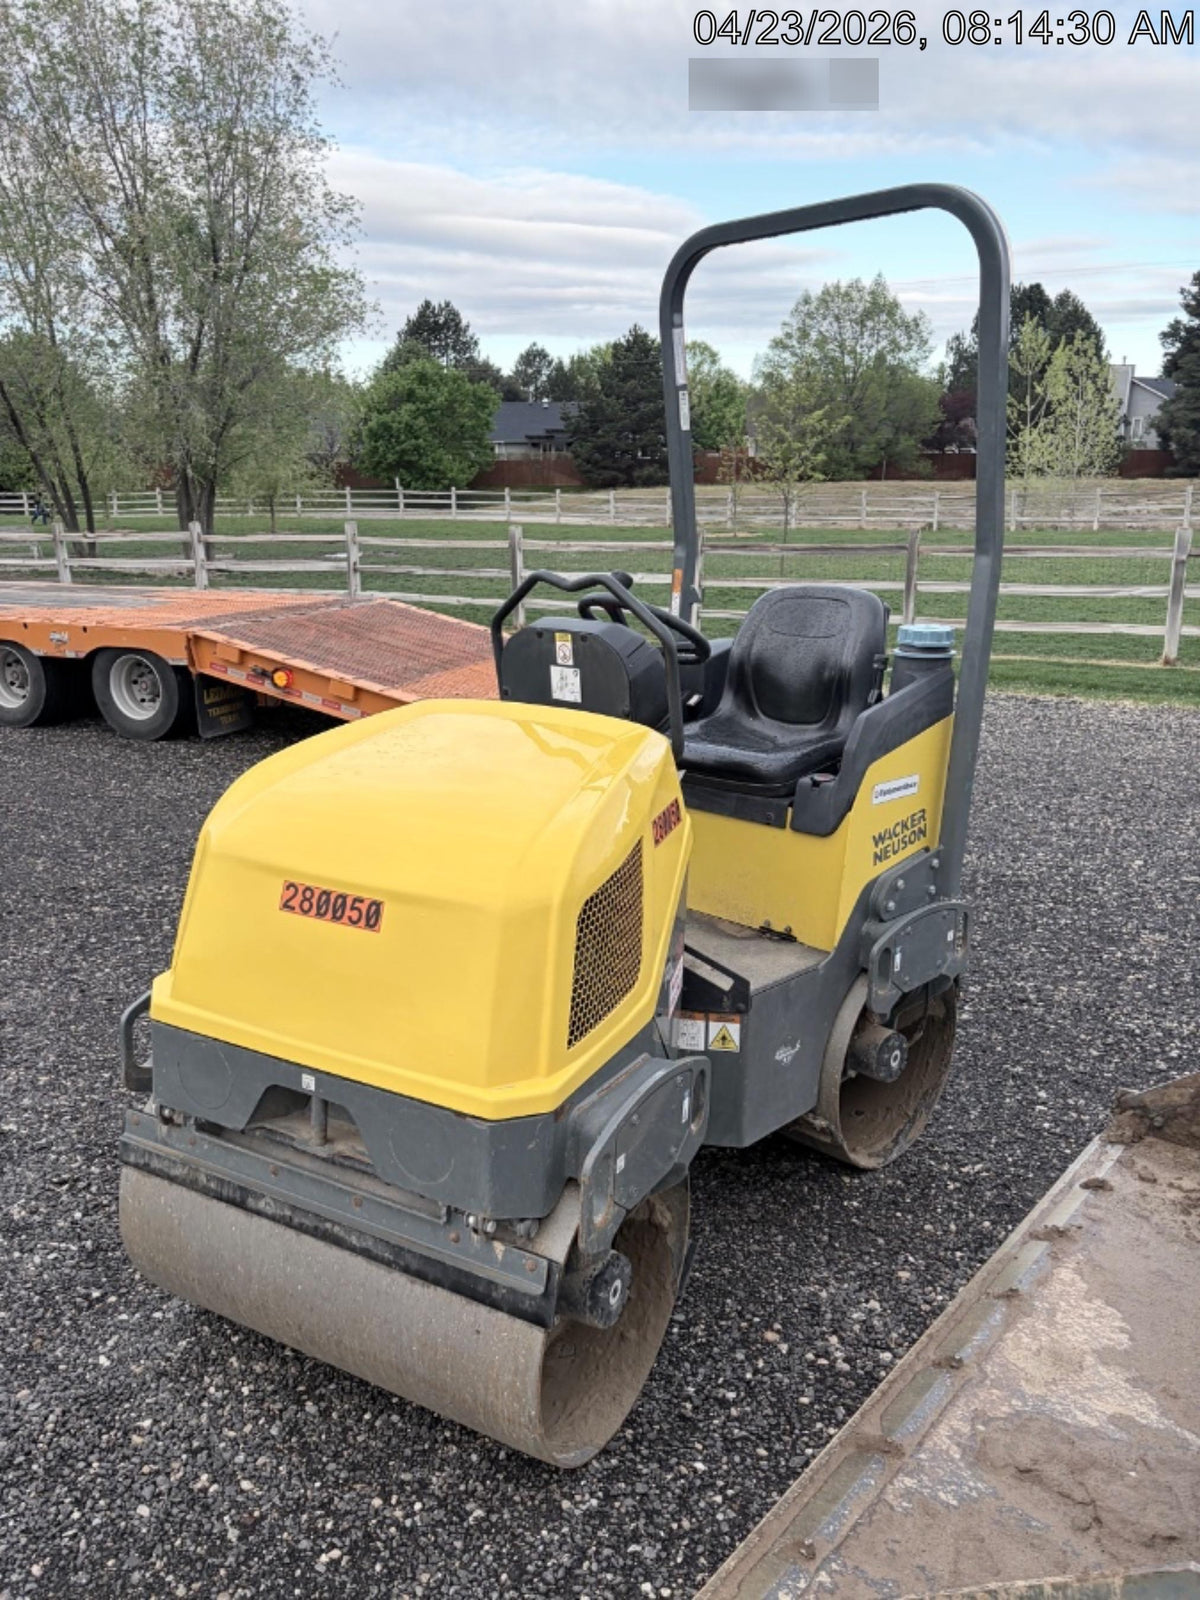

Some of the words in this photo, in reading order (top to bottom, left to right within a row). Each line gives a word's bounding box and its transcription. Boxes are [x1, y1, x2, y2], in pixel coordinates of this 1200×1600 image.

[872, 808, 927, 849] WACKER
[873, 823, 928, 867] NEUSON
[282, 882, 382, 929] 280050
